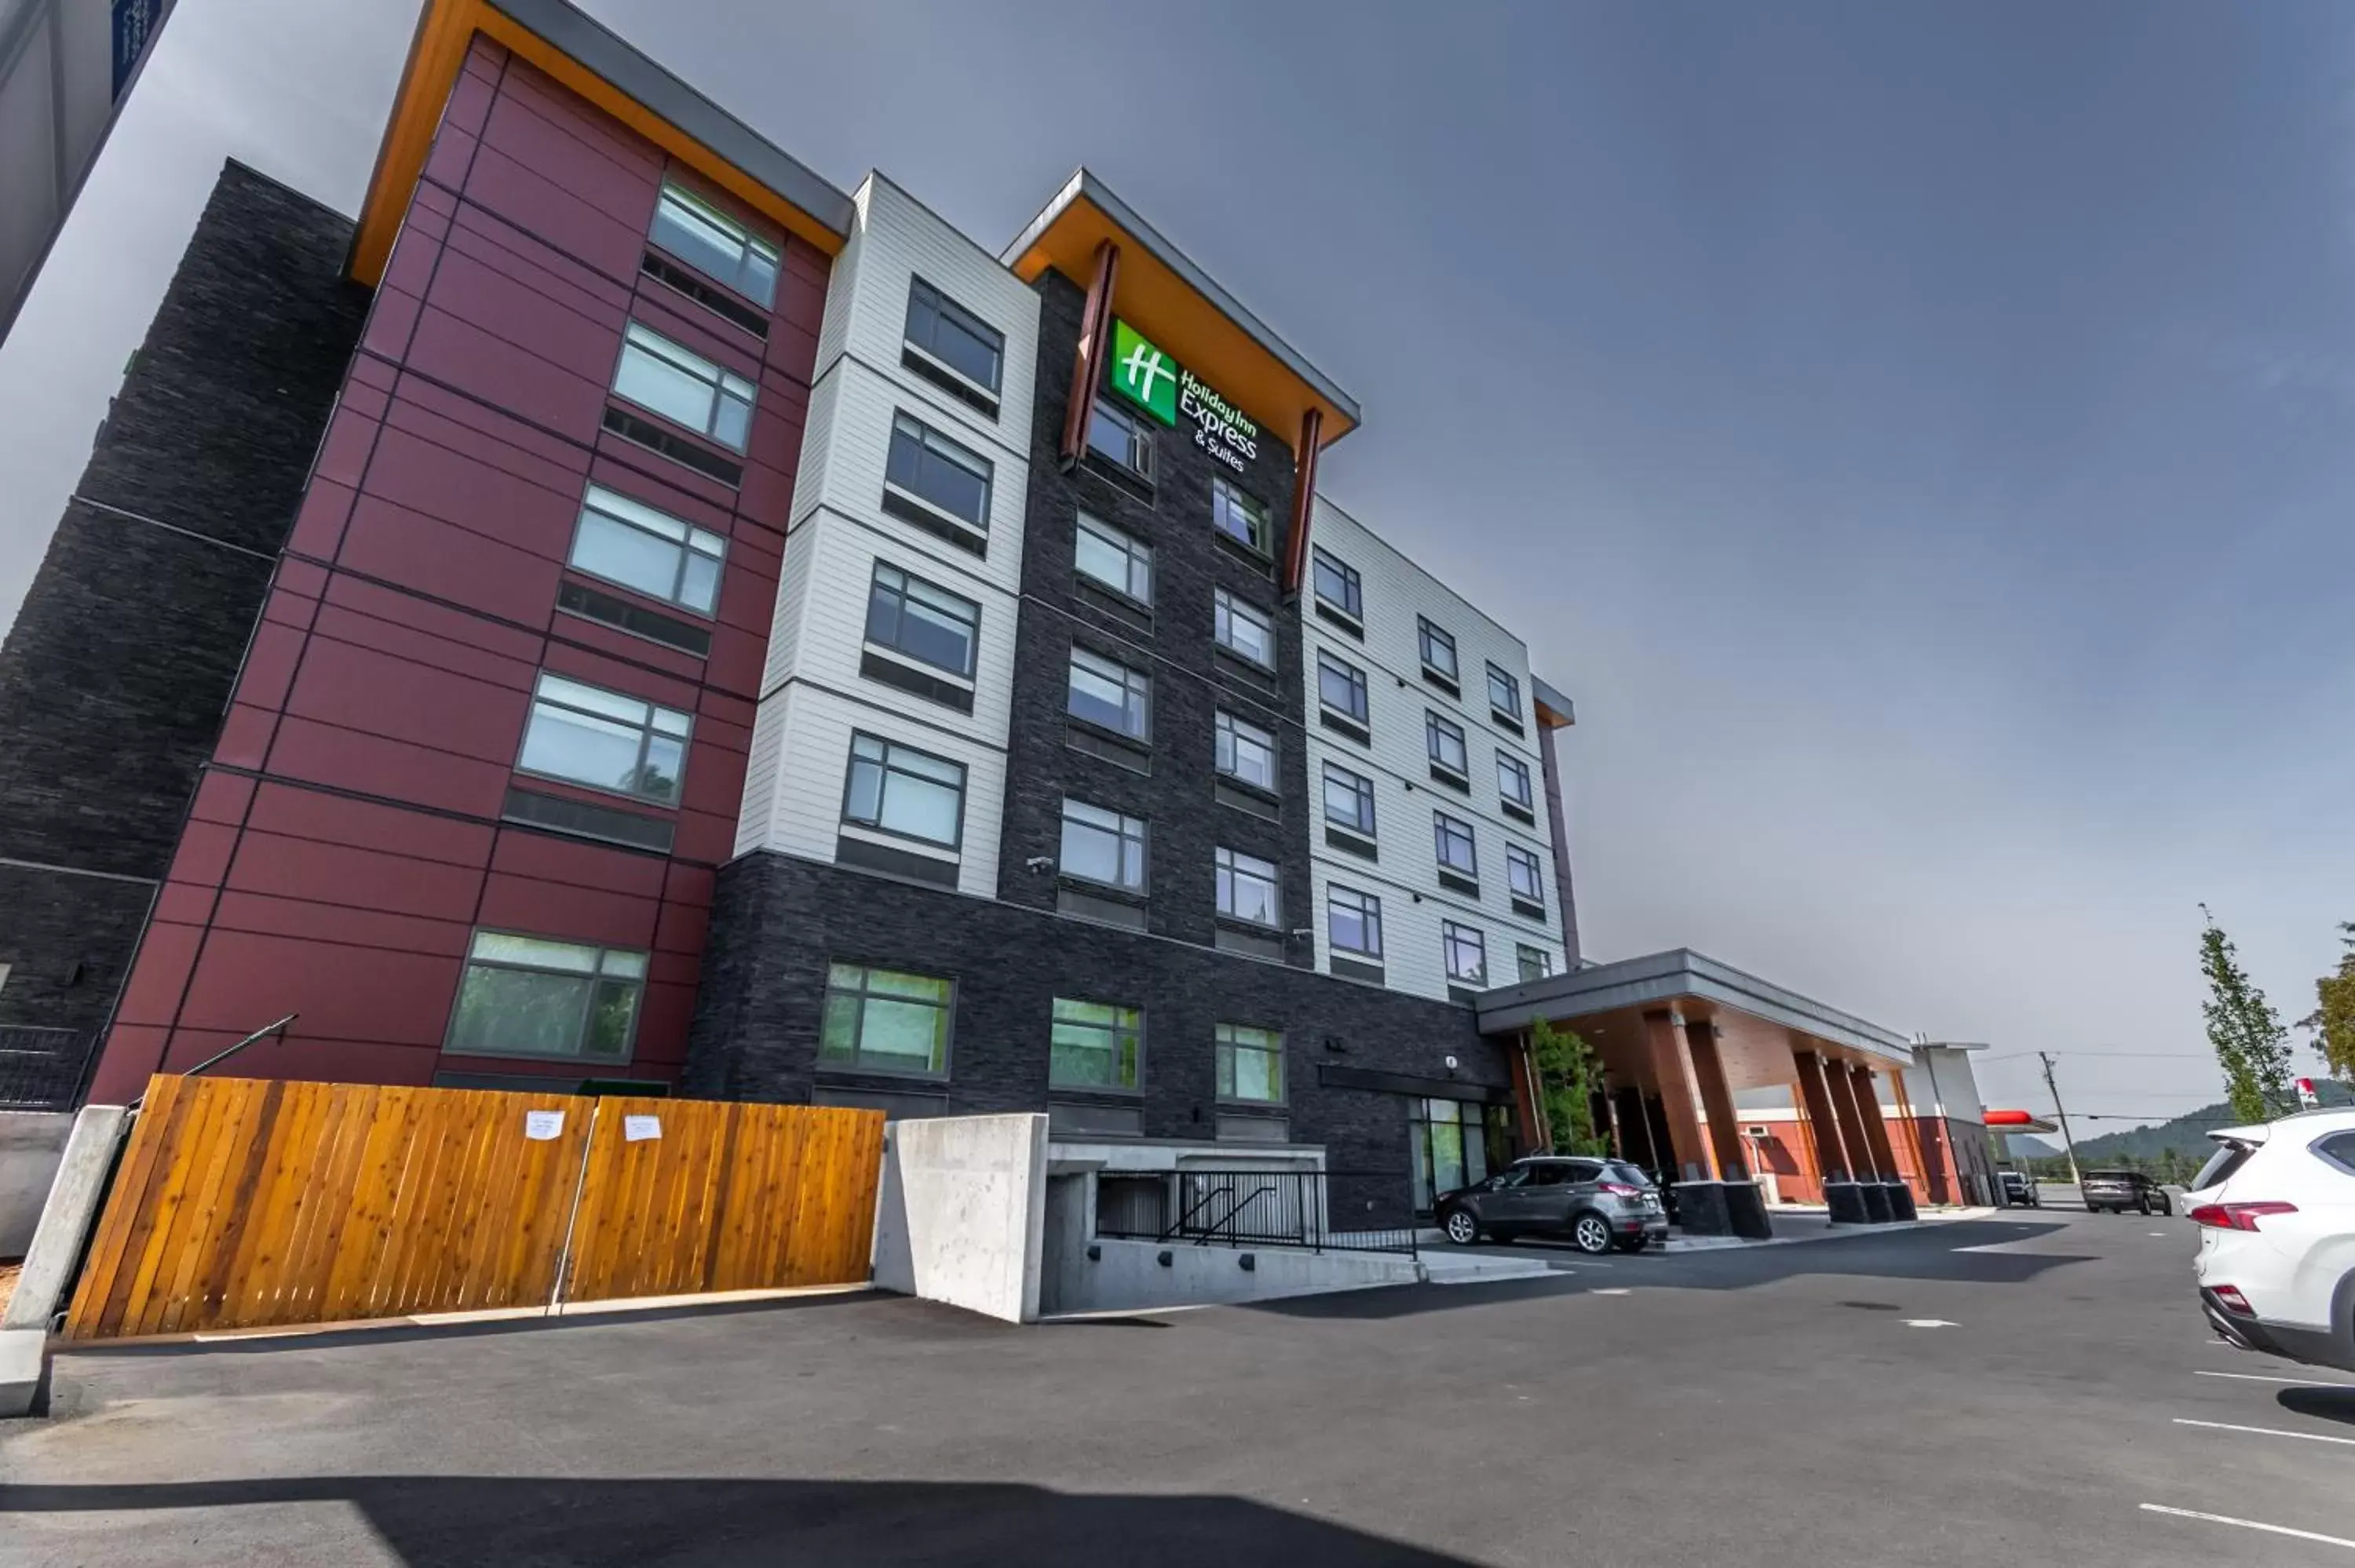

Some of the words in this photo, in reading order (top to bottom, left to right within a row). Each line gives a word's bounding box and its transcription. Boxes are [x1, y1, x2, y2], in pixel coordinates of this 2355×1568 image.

[1180, 389, 1256, 460] Express
[1181, 370, 1235, 424] Holiday
[1235, 408, 1256, 436] Inn
[1195, 429, 1206, 447] &
[1207, 438, 1243, 472] Suites
